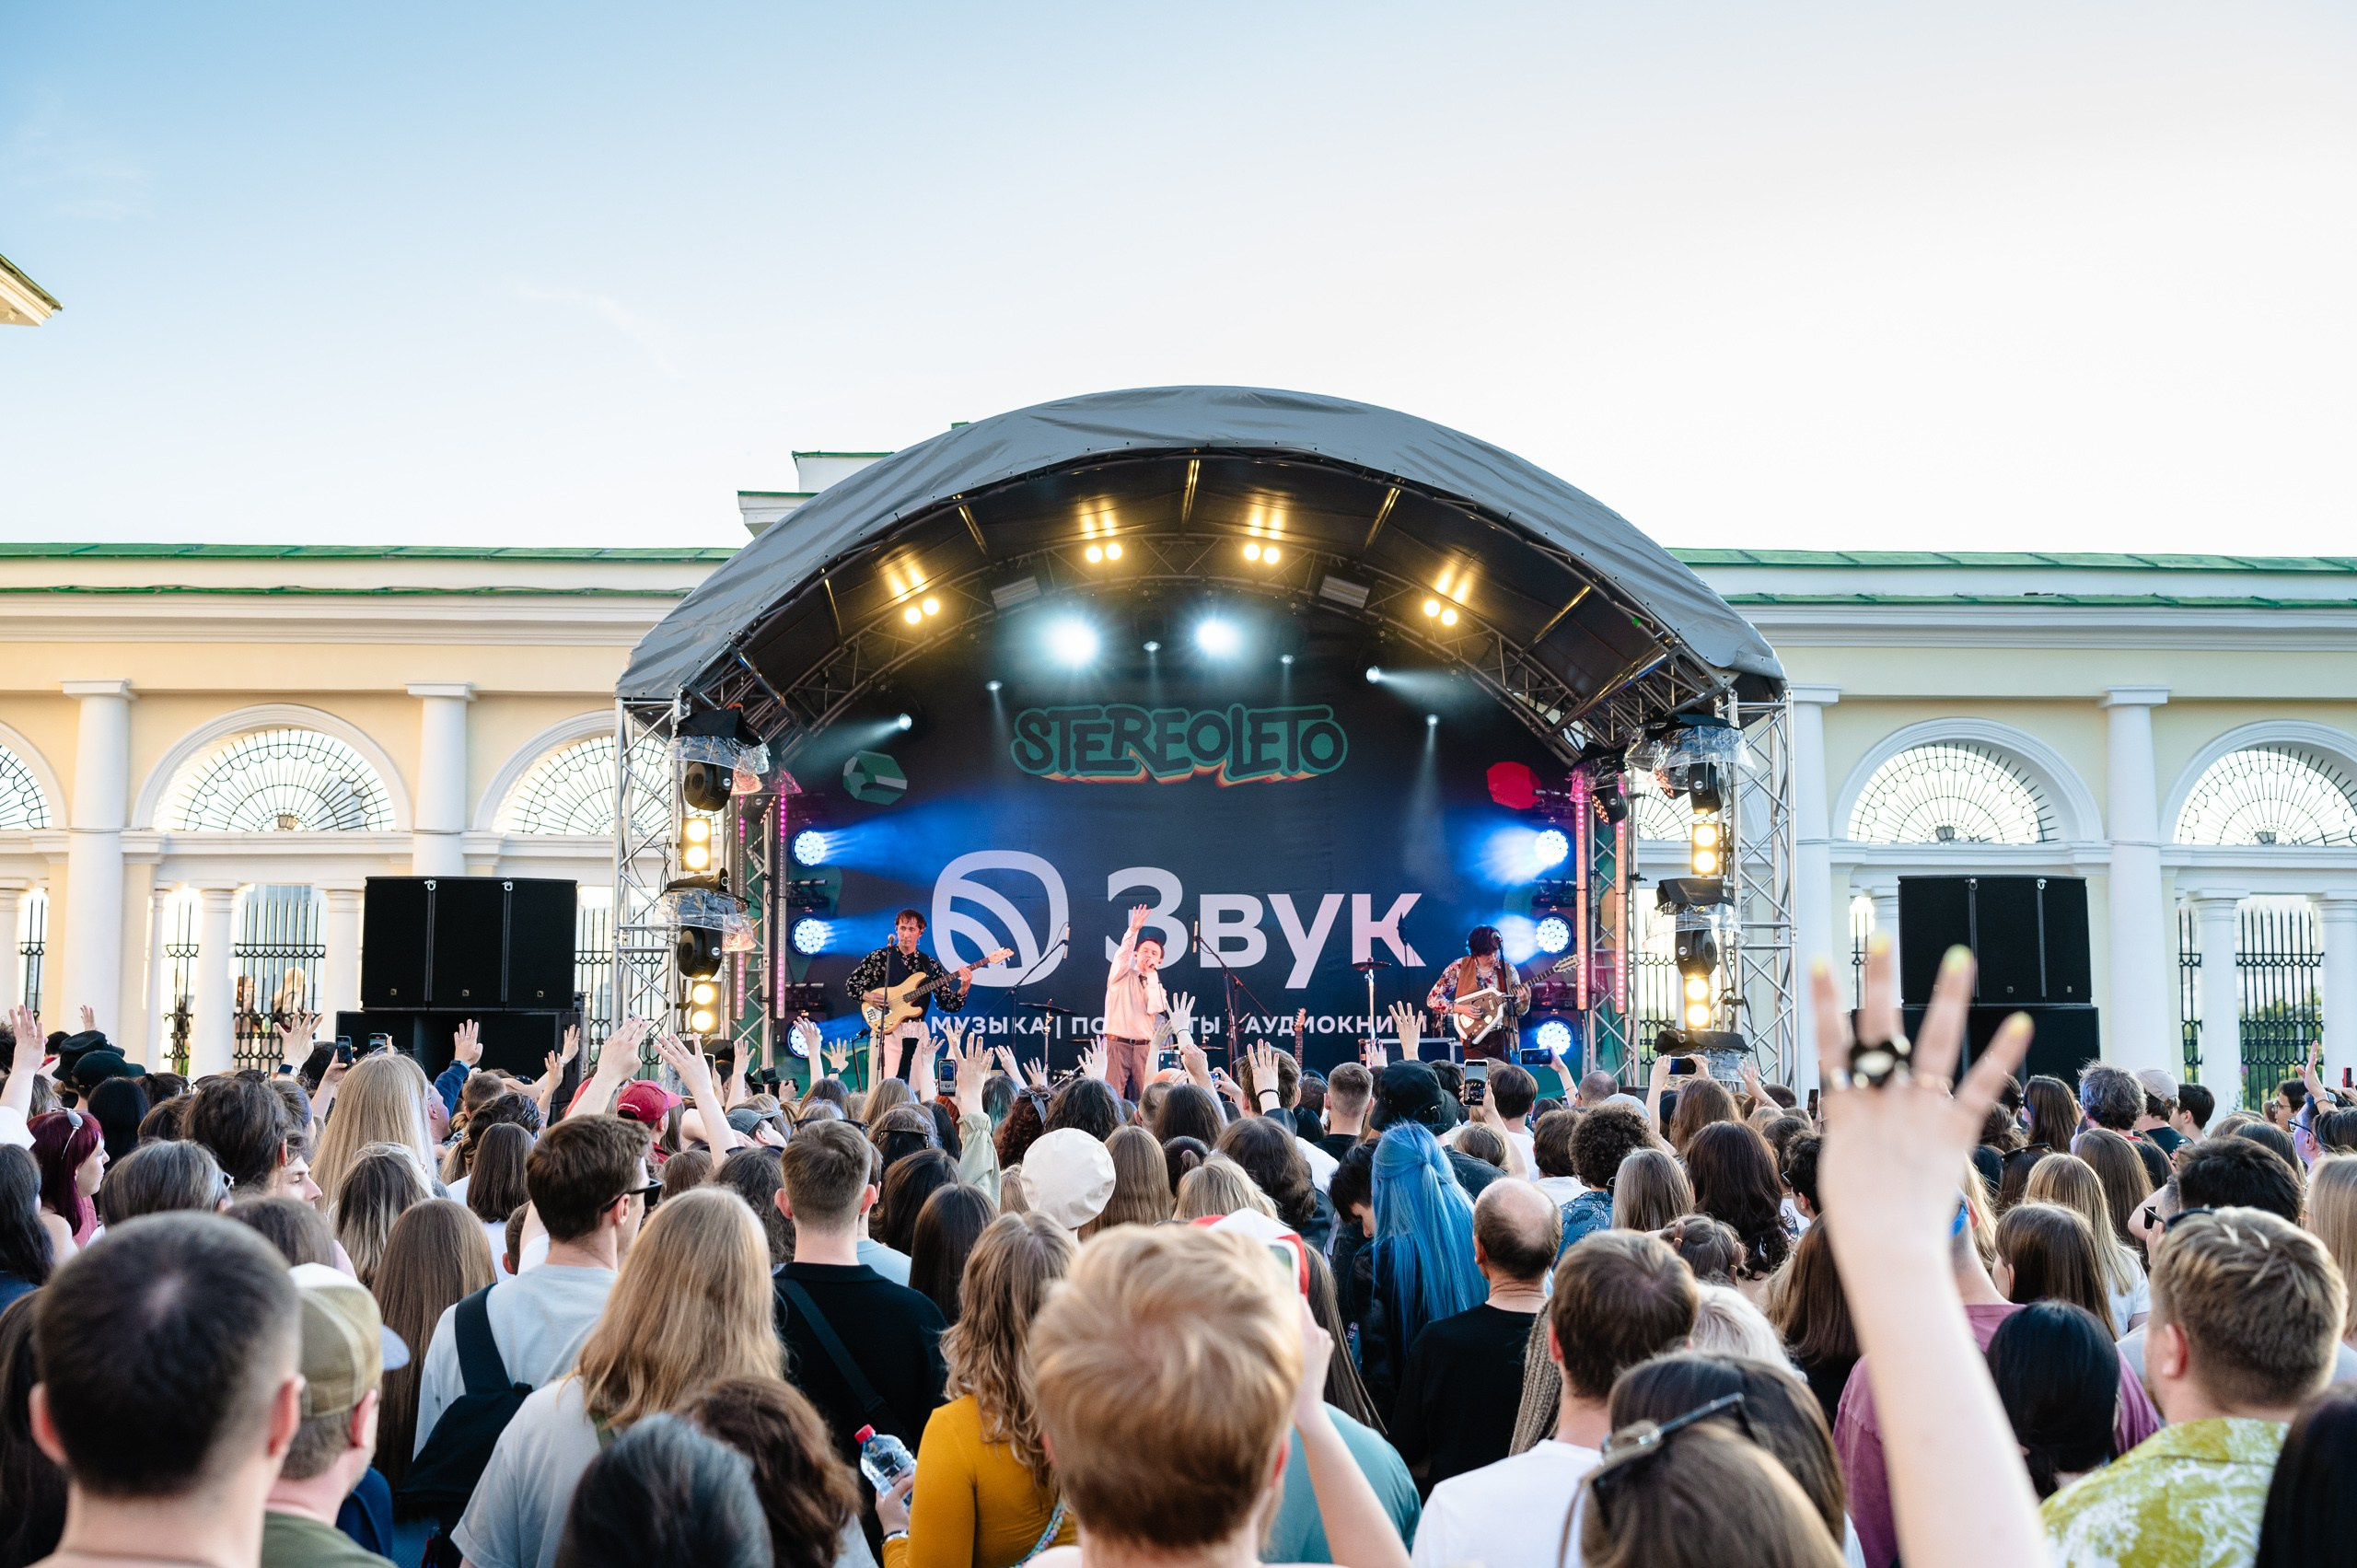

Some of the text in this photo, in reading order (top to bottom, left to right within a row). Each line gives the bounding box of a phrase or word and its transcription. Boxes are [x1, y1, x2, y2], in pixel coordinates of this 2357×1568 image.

[1011, 703, 1348, 786] STEREOLETO
[1106, 866, 1427, 989] Звук
[931, 1016, 1046, 1035] МУЗЫКА
